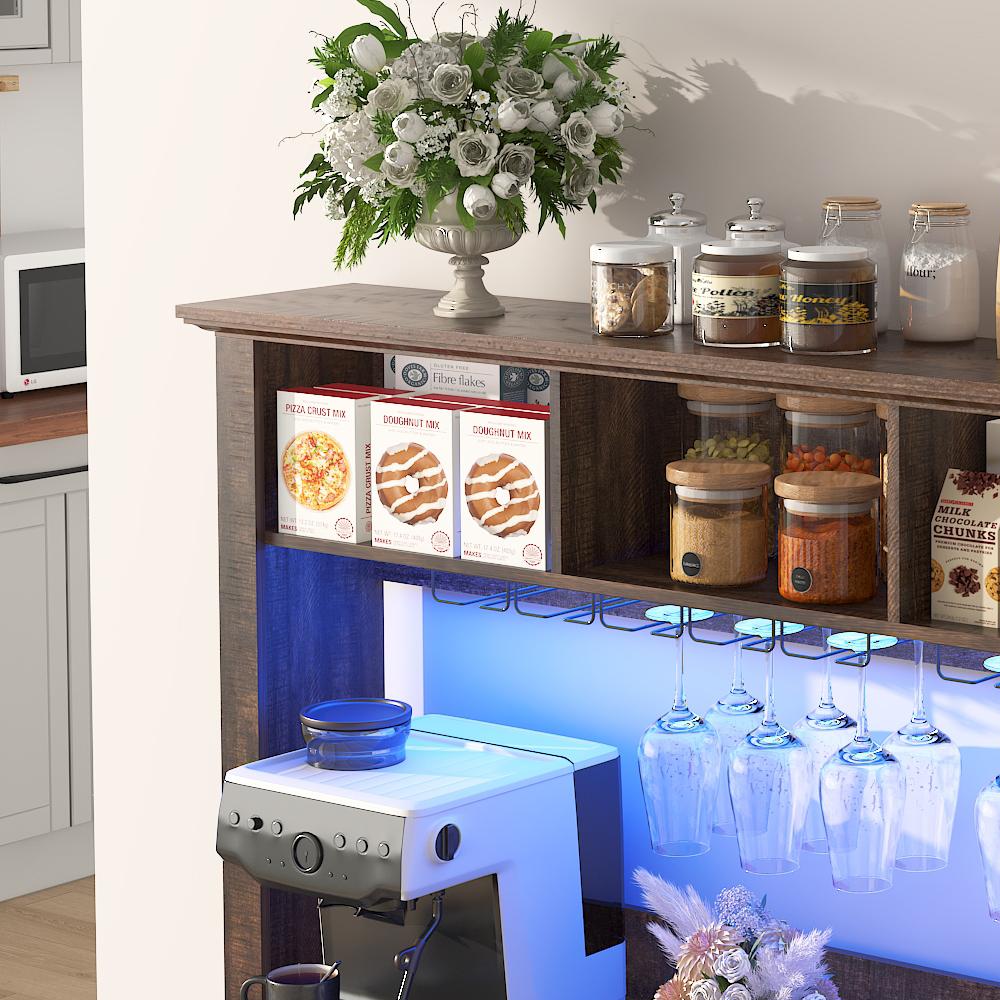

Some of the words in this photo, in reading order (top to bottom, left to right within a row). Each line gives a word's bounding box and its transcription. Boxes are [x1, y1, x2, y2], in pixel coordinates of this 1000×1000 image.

[433, 372, 457, 385] Fibre
[459, 374, 486, 388] flakes
[285, 403, 305, 414] PIZZA
[307, 406, 331, 417] CRUST
[332, 409, 346, 418] MIX
[383, 414, 424, 428] DOUGHNUT
[426, 420, 440, 430] MIX
[473, 425, 515, 438] DOUGHNUT
[517, 431, 532, 441] MIX
[938, 506, 971, 517] MILK
[935, 515, 998, 529] CHOCOLATE
[934, 525, 996, 540] CHUNKS
[374, 537, 392, 545] MAKES
[463, 550, 482, 558] MAKES
